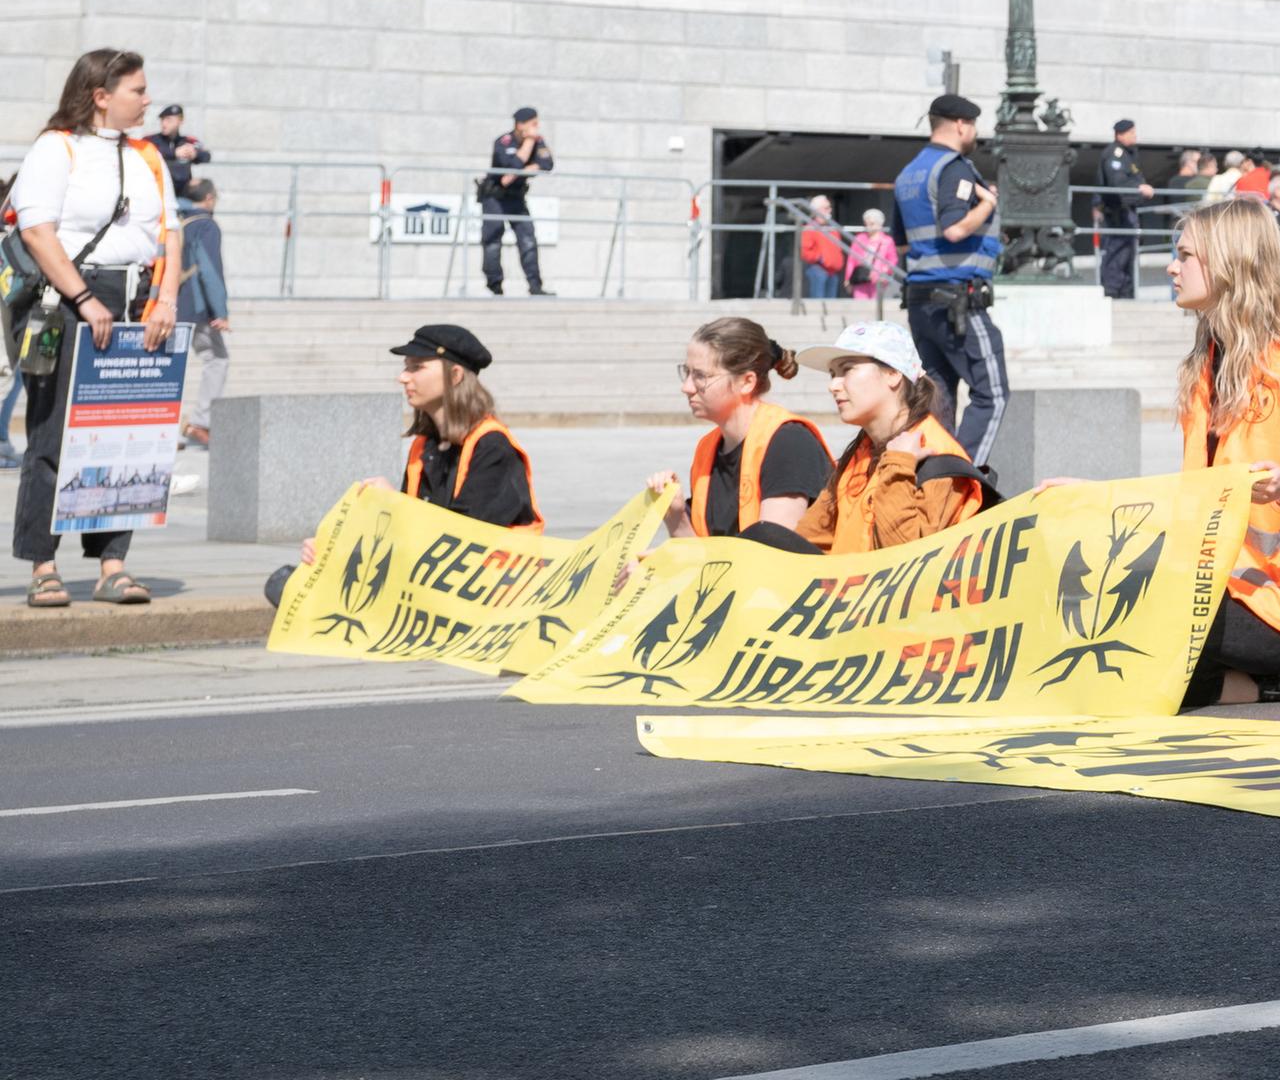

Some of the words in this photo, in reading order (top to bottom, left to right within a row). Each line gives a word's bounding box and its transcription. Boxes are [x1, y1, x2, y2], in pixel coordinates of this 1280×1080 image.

[99, 368, 139, 379] EHRLICH
[408, 533, 555, 608] RECHT
[769, 545, 946, 640] RECHT
[931, 513, 1038, 614] AUF
[1192, 486, 1234, 618] GENERATION.AT
[281, 592, 306, 632] LETZTE
[695, 622, 1026, 705] ÜBERLEBEN
